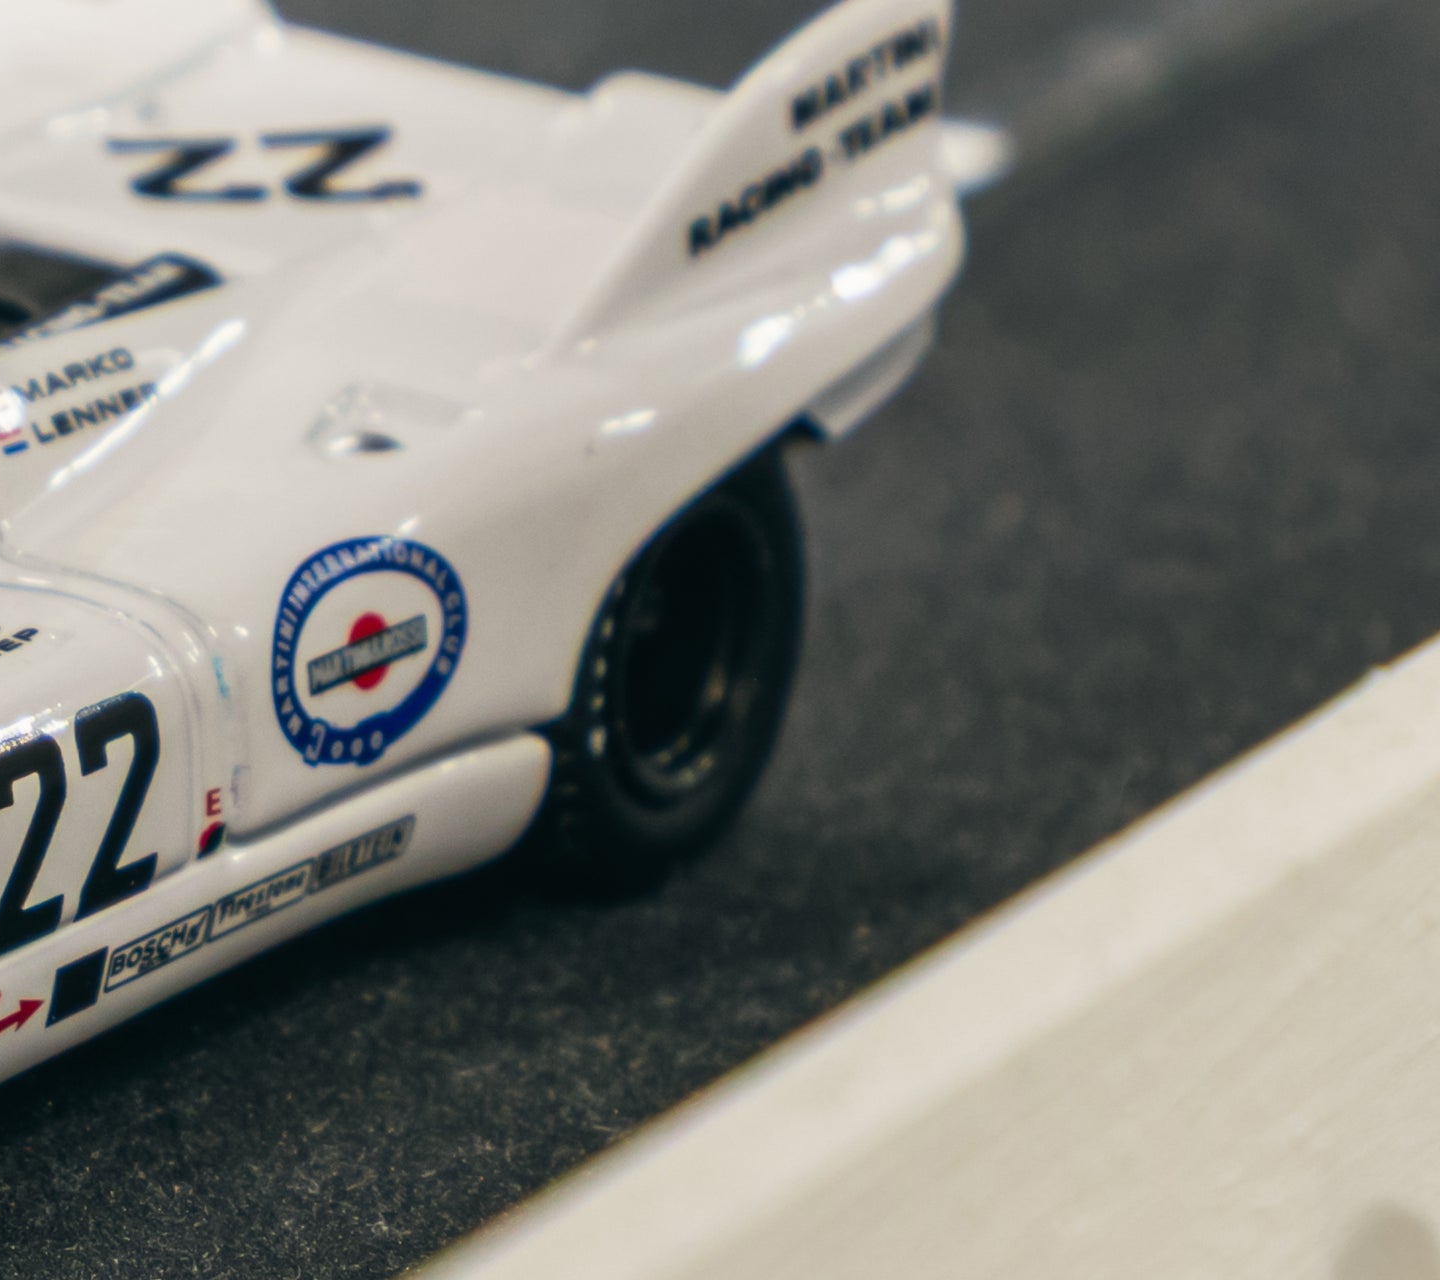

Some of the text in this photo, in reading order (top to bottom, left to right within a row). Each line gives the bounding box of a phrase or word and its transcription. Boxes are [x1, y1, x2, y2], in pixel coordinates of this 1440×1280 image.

[12, 348, 134, 402] MARKO
[205, 787, 221, 816] E
[108, 919, 193, 977] BOSCH
